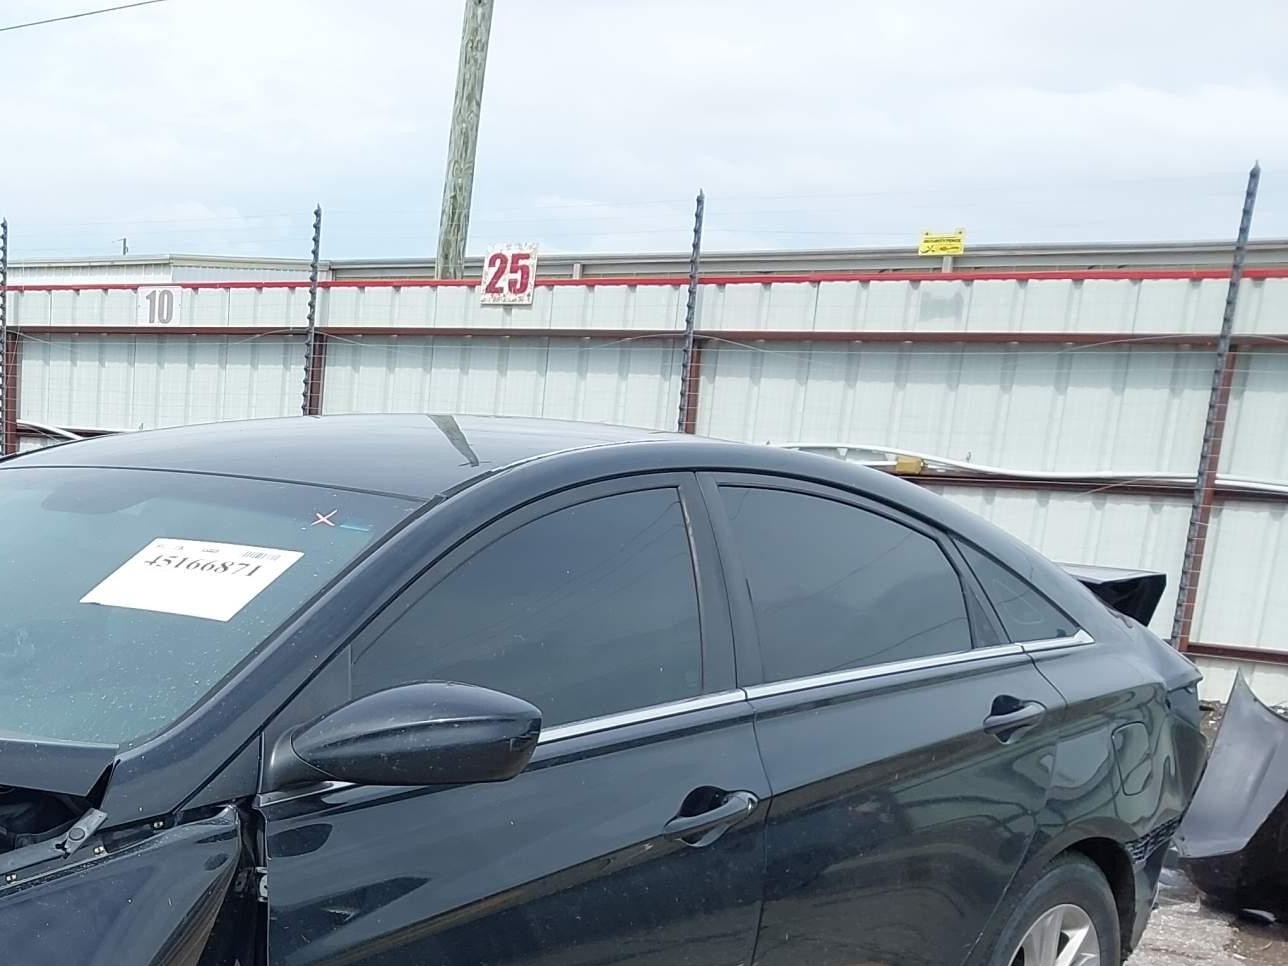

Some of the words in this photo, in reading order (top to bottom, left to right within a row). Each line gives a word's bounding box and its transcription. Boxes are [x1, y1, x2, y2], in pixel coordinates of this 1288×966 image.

[485, 252, 531, 295] 25
[145, 289, 174, 324] 10
[144, 553, 262, 577] 45166871
